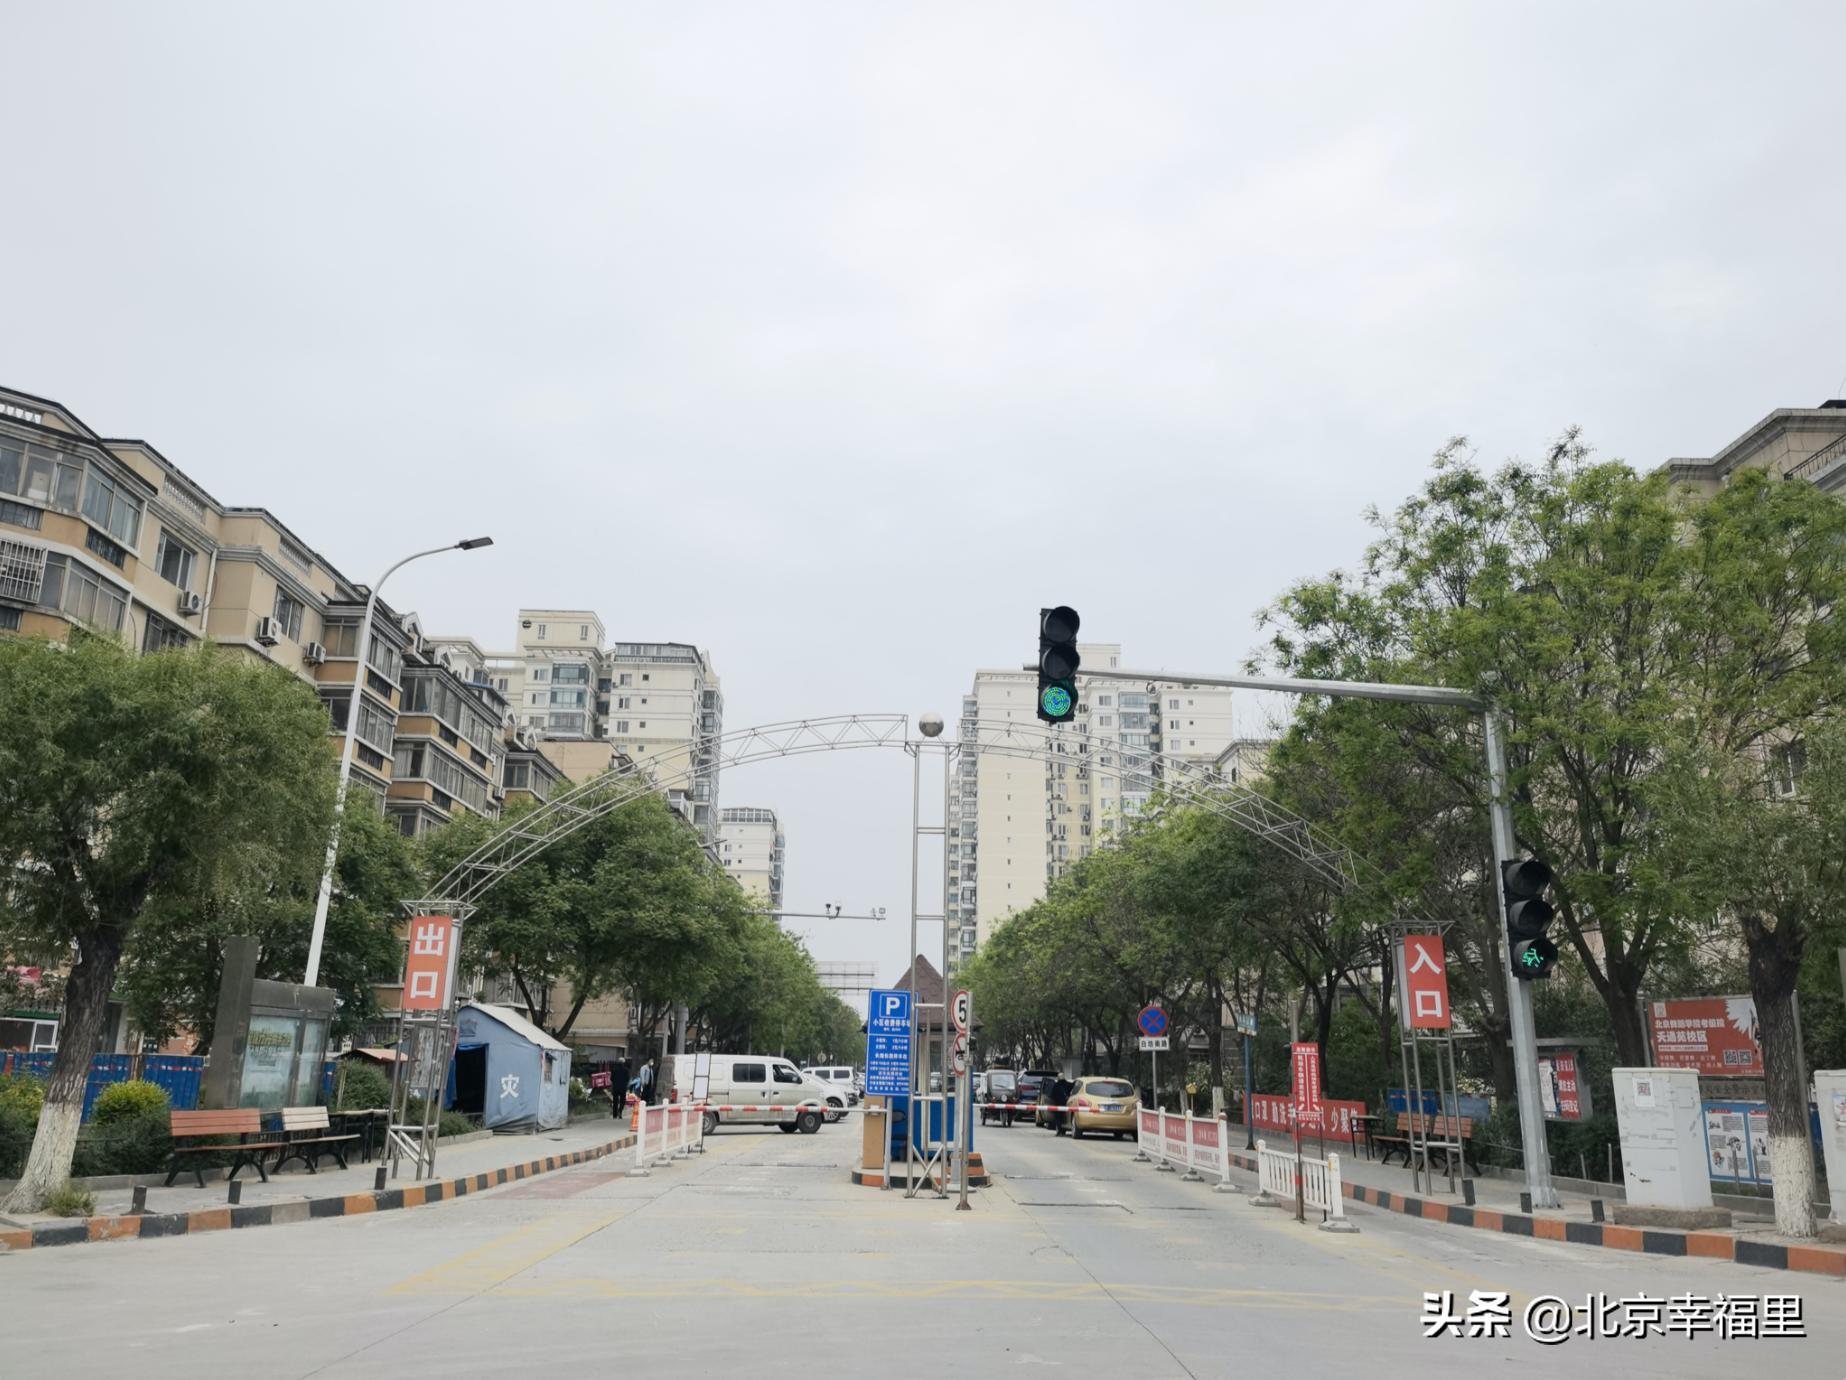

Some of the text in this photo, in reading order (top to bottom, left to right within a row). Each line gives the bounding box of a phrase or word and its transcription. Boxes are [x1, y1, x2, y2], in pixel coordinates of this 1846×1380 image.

[410, 923, 444, 999] 出口
[1410, 943, 1442, 1018] 入口
[886, 997, 900, 1015] P
[959, 1000, 966, 1023] 5
[1657, 1030, 1707, 1043] 天通苑校区
[500, 1074, 520, 1098] 灾
[1251, 1100, 1268, 1120] 口罩
